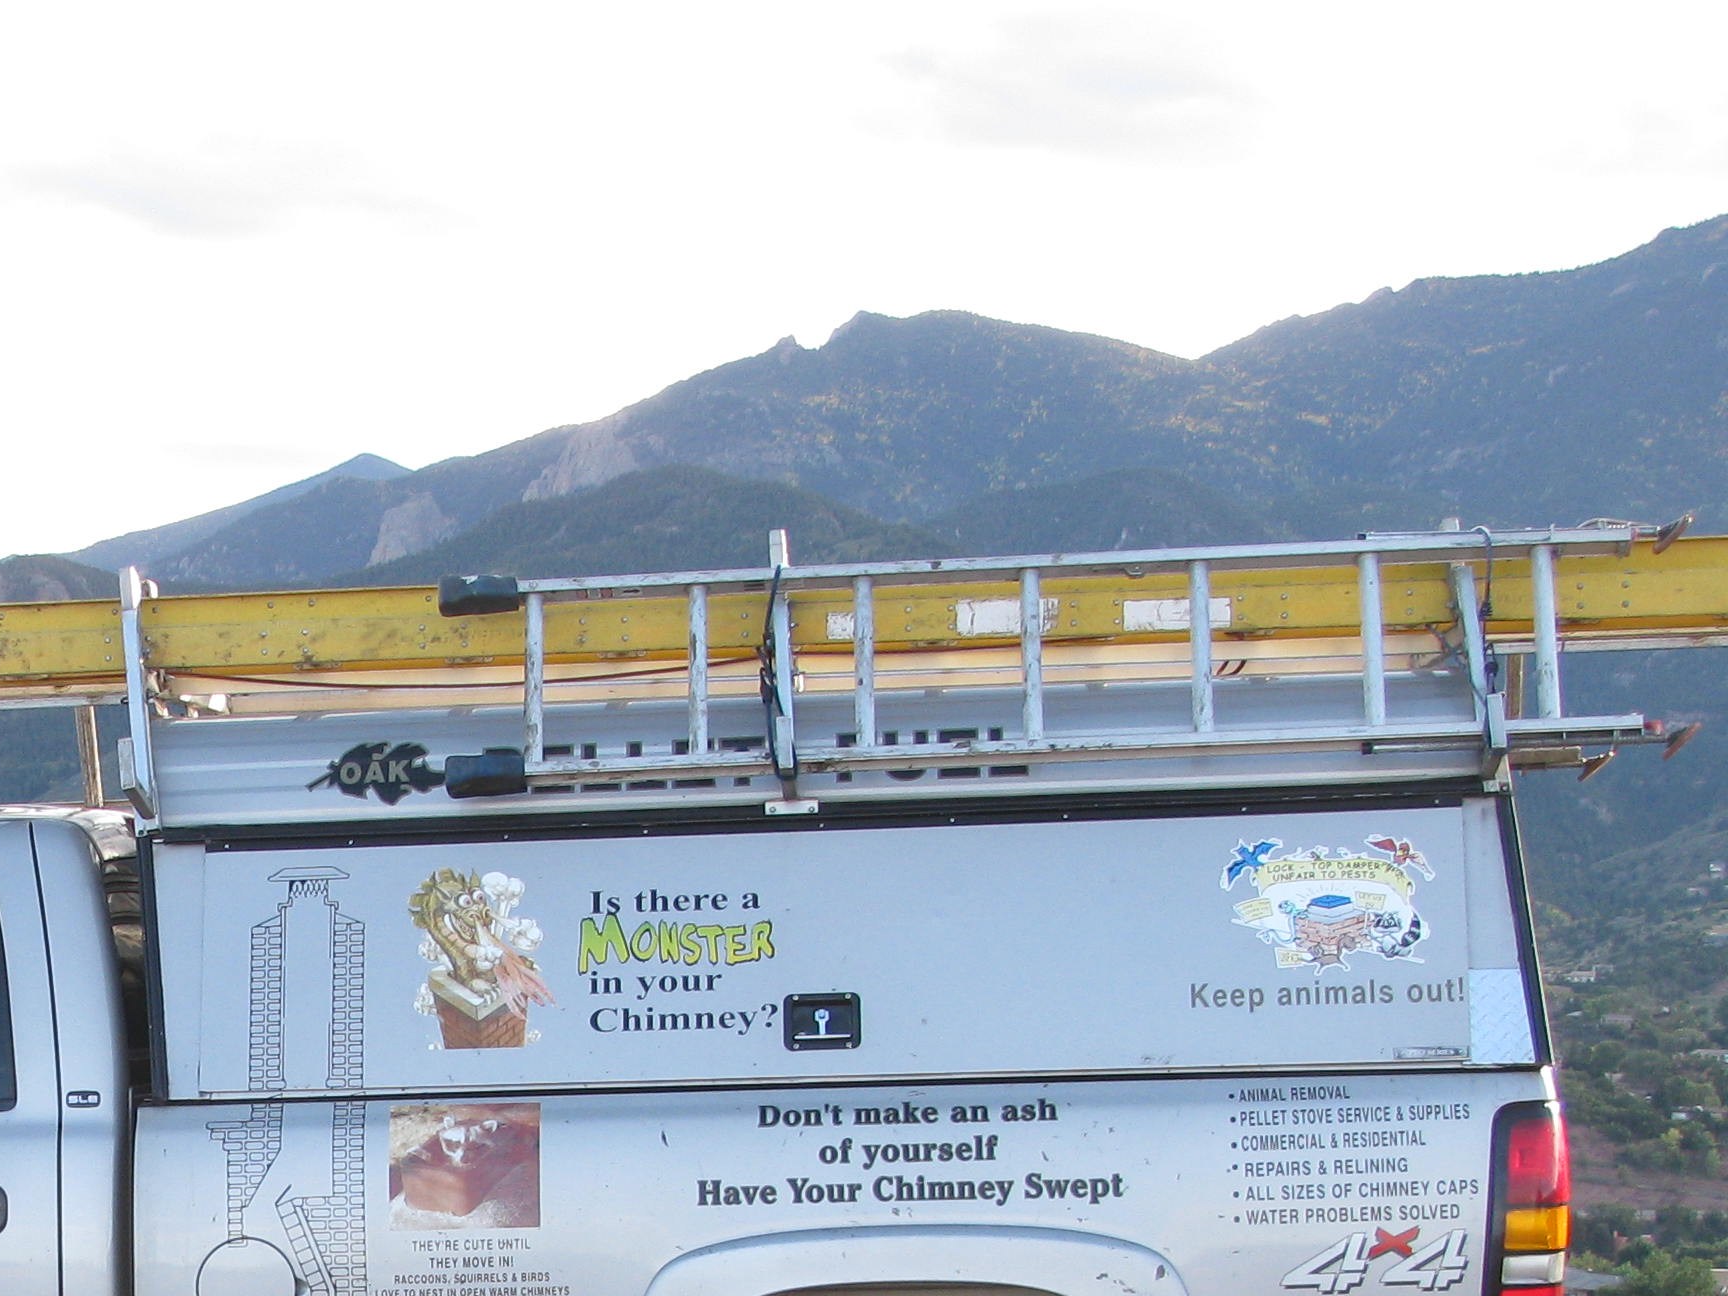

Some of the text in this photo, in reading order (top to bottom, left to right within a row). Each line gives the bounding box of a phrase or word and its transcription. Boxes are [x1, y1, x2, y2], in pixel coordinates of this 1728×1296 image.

[339, 760, 411, 785] OAK
[1272, 871, 1315, 881] UNFAIR
[1322, 870, 1336, 879] TO
[1341, 870, 1376, 879] PESTS
[1312, 861, 1334, 869] TOP
[591, 888, 760, 916] Is there a
[577, 914, 775, 974] MONSTER
[589, 969, 723, 1000] in your
[1190, 977, 1465, 1012] Keep animals out!
[589, 1002, 778, 1036] Chimney?
[1238, 1085, 1350, 1102] ANIMAL REMOVAL
[757, 1098, 1059, 1128] Don't make an ash
[1240, 1103, 1470, 1126] PELLET STOVE SERVICE & SUPPLIES
[1241, 1130, 1427, 1151] COMMERCIAL & RESIDENTIAL
[818, 1134, 998, 1170] of yourself
[1244, 1157, 1408, 1177] REPAIRS & RELINING
[697, 1172, 1123, 1206] Have Your Chimney Swept
[1246, 1179, 1479, 1201] ALL SIZES OF CHIMNEY CAPS
[1246, 1204, 1460, 1225] WATER PROBLEMS SOLVED
[412, 1237, 531, 1252] THEY'RE CUTE UNTIL
[429, 1255, 514, 1269] THEY MOVE IN!
[454, 1272, 508, 1284] SQUIRRELS
[511, 1272, 518, 1282] &
[521, 1271, 550, 1282] BIRDS
[489, 1286, 517, 1296] WARM
[520, 1285, 570, 1296] CHIMNEYS
